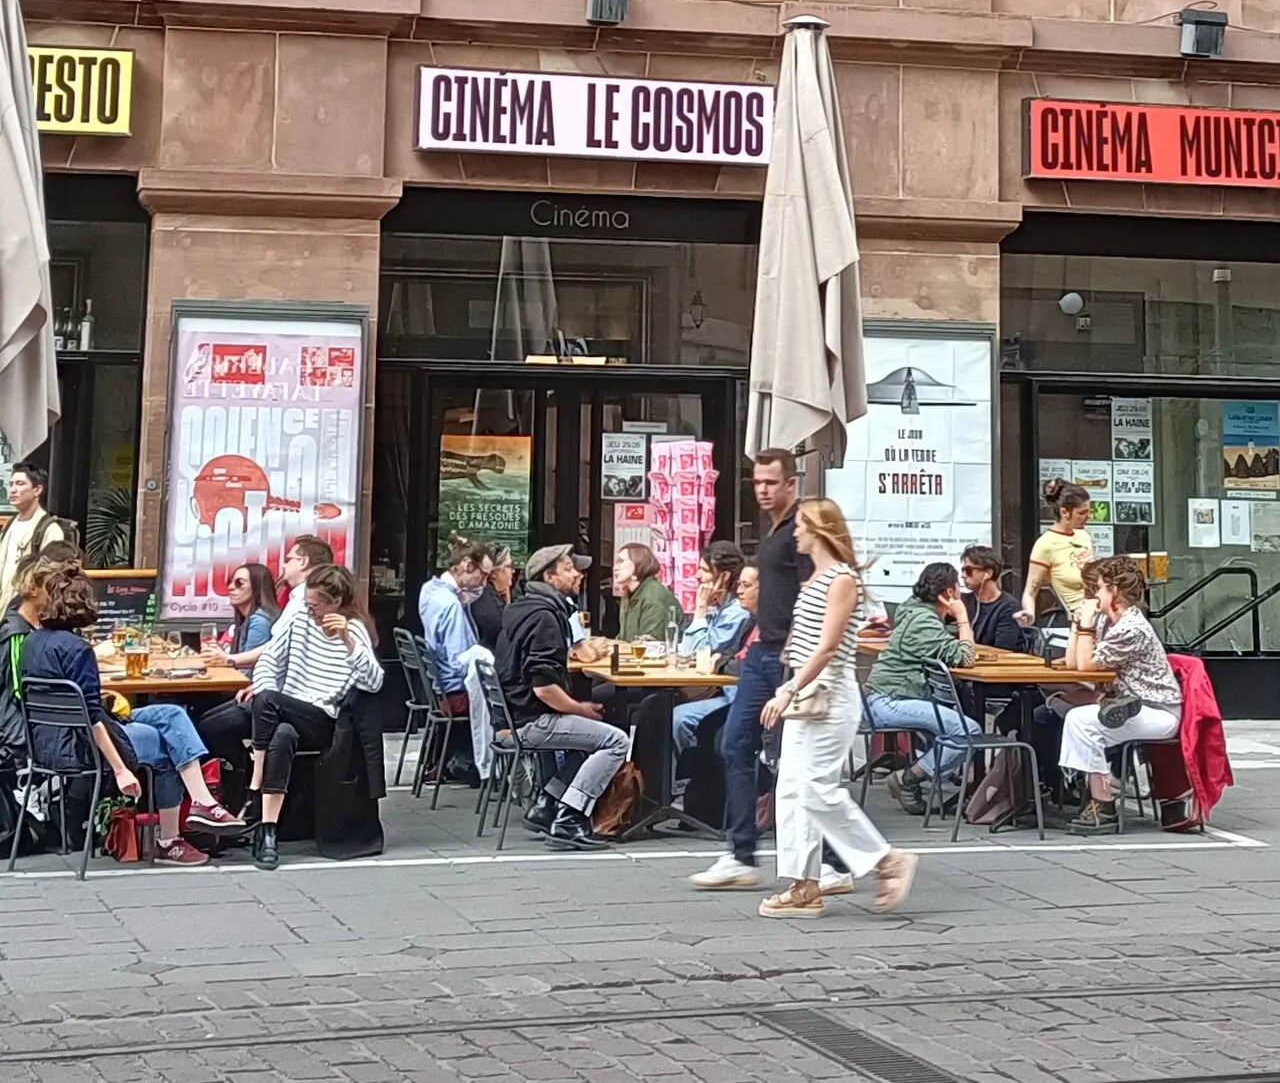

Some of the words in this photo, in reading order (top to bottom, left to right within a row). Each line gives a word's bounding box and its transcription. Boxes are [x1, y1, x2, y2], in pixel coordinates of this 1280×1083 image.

[28, 54, 121, 125] ESTO
[430, 70, 555, 147] CINÉMA
[586, 82, 620, 150] LE
[630, 85, 765, 158] COSMOS
[1039, 104, 1153, 174] CINÉMA
[530, 199, 630, 230] Cinéma
[1113, 418, 1123, 428] LA
[1125, 418, 1151, 428] HAINE
[897, 429, 906, 440] LE
[603, 454, 614, 464] LA
[616, 454, 644, 465] HAINE
[878, 468, 943, 496] S'ARRÊTA
[457, 503, 475, 512] LES
[478, 503, 521, 513] SECRETS
[449, 511, 468, 521] DES
[470, 512, 521, 522] FRESQUES
[458, 520, 521, 530] D'AMAZONIE
[170, 602, 199, 614] Cycle
